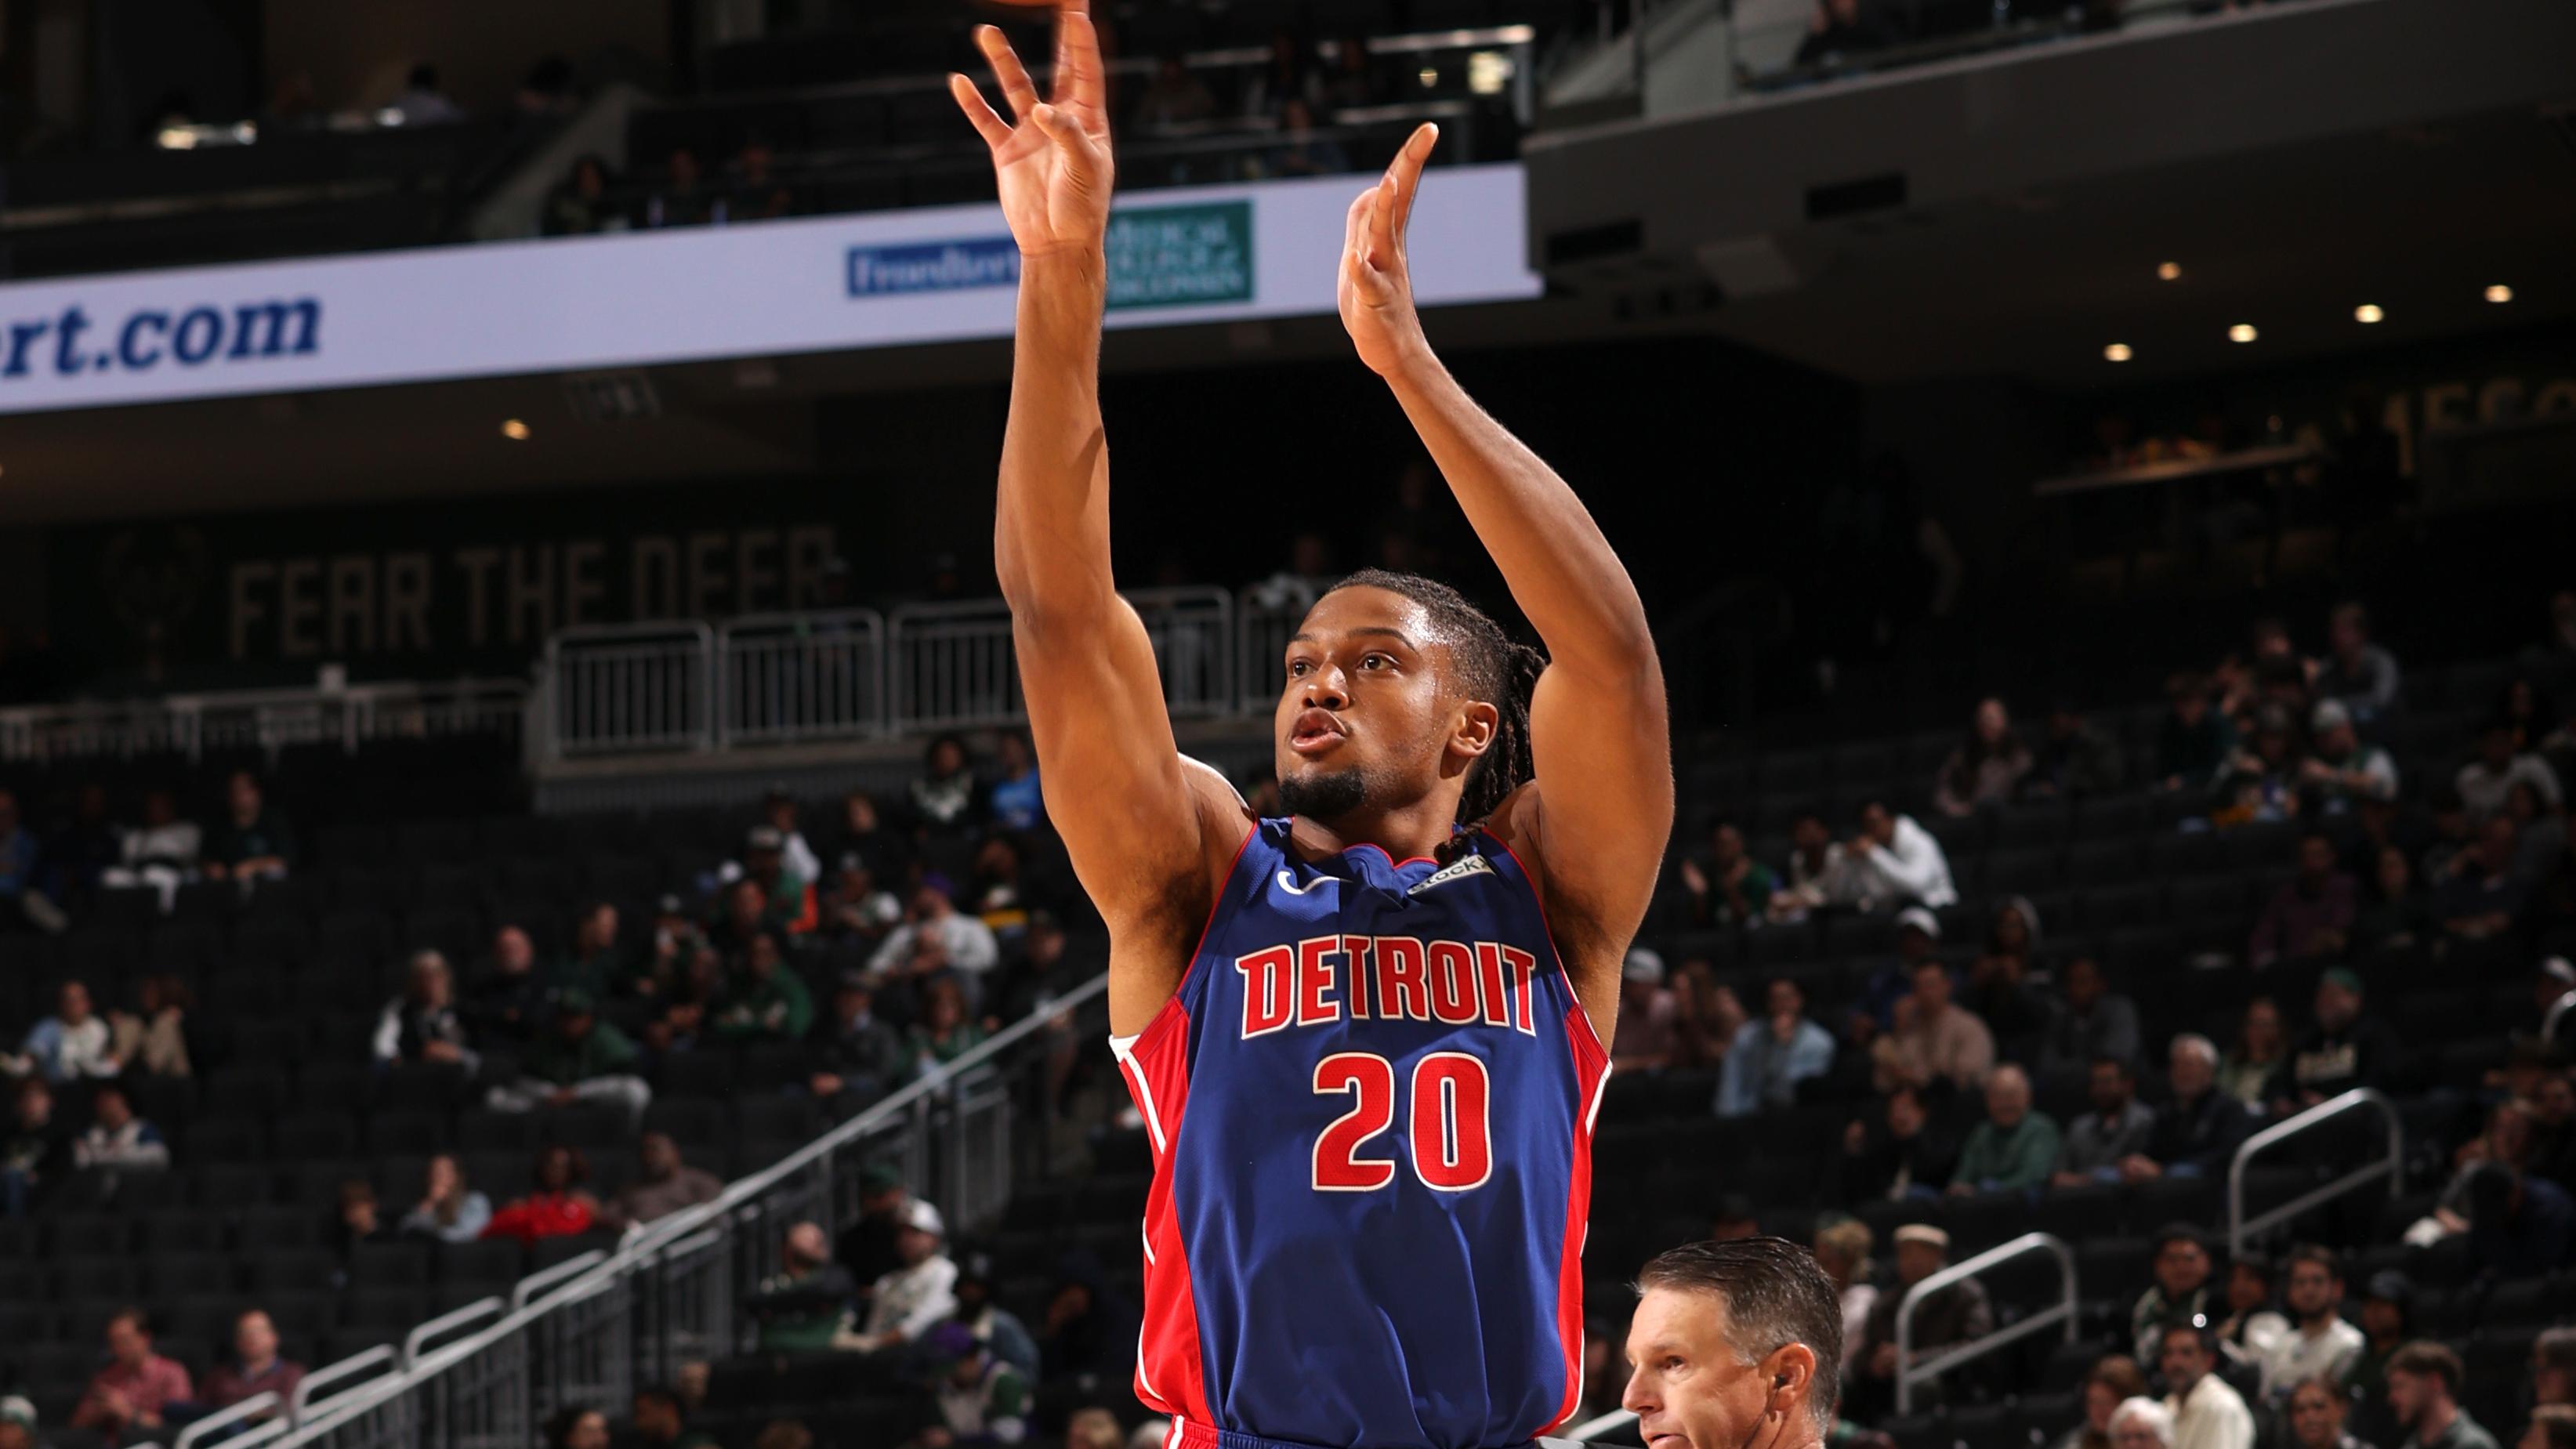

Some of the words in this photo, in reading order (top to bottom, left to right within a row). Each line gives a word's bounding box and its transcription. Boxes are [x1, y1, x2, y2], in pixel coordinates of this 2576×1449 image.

[0, 298, 322, 377] rt.com
[230, 551, 436, 660] FEAR
[453, 539, 607, 649] THE
[632, 524, 840, 619] DEER
[1236, 933, 1537, 1040] DETROIT
[1311, 1052, 1493, 1192] 20
